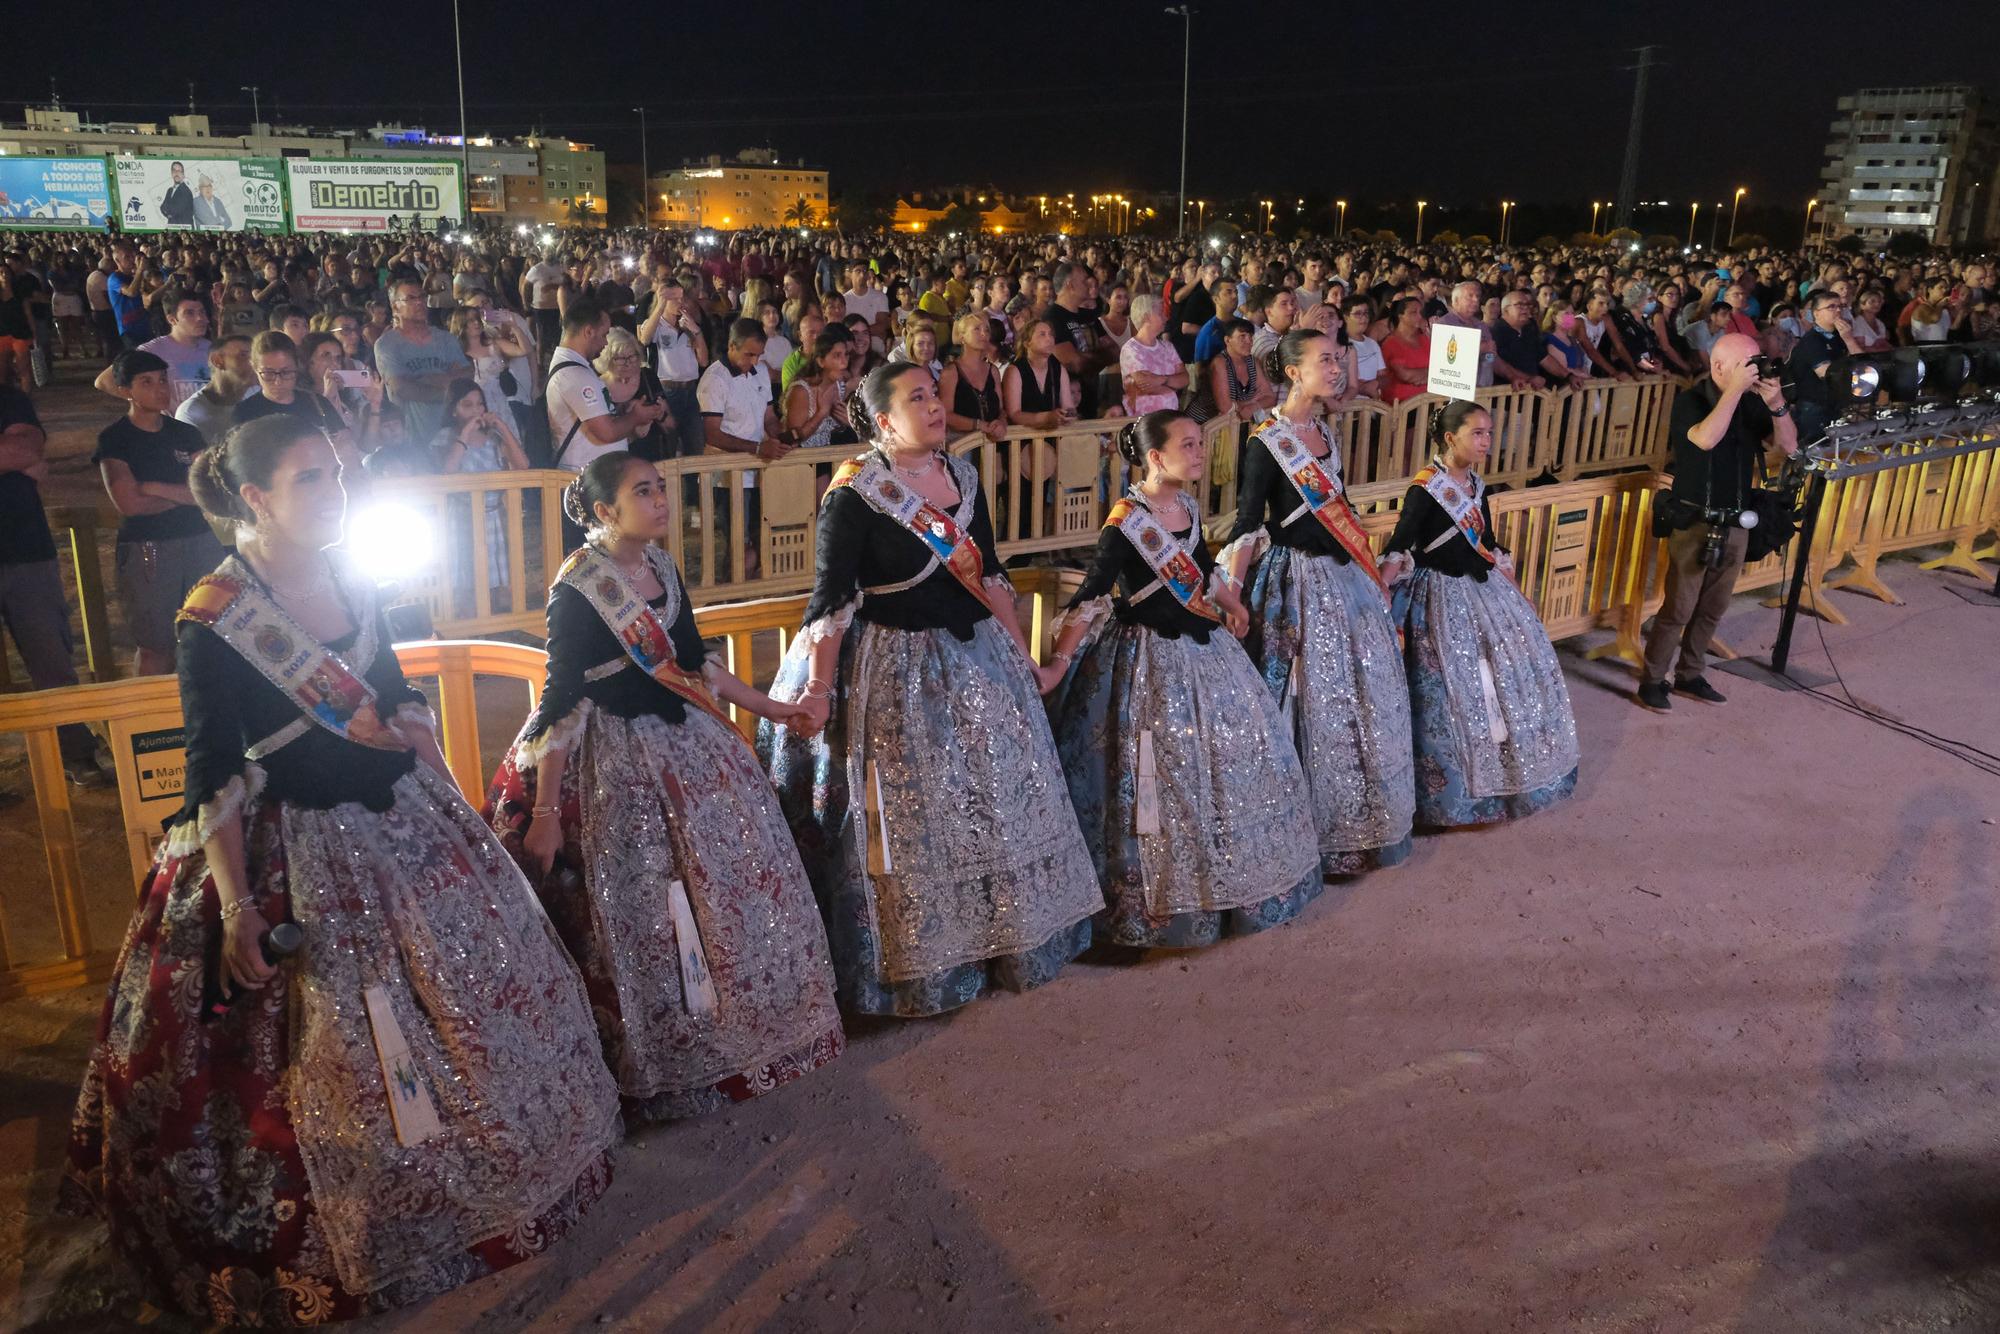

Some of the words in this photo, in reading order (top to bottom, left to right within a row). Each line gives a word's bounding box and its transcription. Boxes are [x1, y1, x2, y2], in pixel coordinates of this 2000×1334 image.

[117, 161, 144, 171] ONDA
[292, 165, 322, 175] ALQUILER
[322, 166, 328, 175] Y
[329, 166, 350, 175] VENTA
[351, 166, 359, 175] DE
[361, 166, 401, 175] FURGONETAS
[403, 166, 414, 175] SIN
[415, 166, 455, 176] CONDUCTOR
[42, 172, 50, 181] A
[52, 172, 84, 181] TODOS
[86, 173, 104, 182] MIS
[44, 182, 105, 192] HERMANOS?
[318, 180, 438, 209] Demetrio
[244, 204, 280, 213] MINUTOS
[125, 214, 146, 222] radio
[420, 219, 437, 229] 500
[1439, 368, 1462, 378] PROTOCOLO
[1453, 382, 1471, 391] GESTORA
[1289, 454, 1306, 468] 2022
[900, 496, 917, 514] 2022
[1153, 544, 1173, 562] 2022
[615, 600, 637, 622] 2022
[282, 649, 312, 679] 2022
